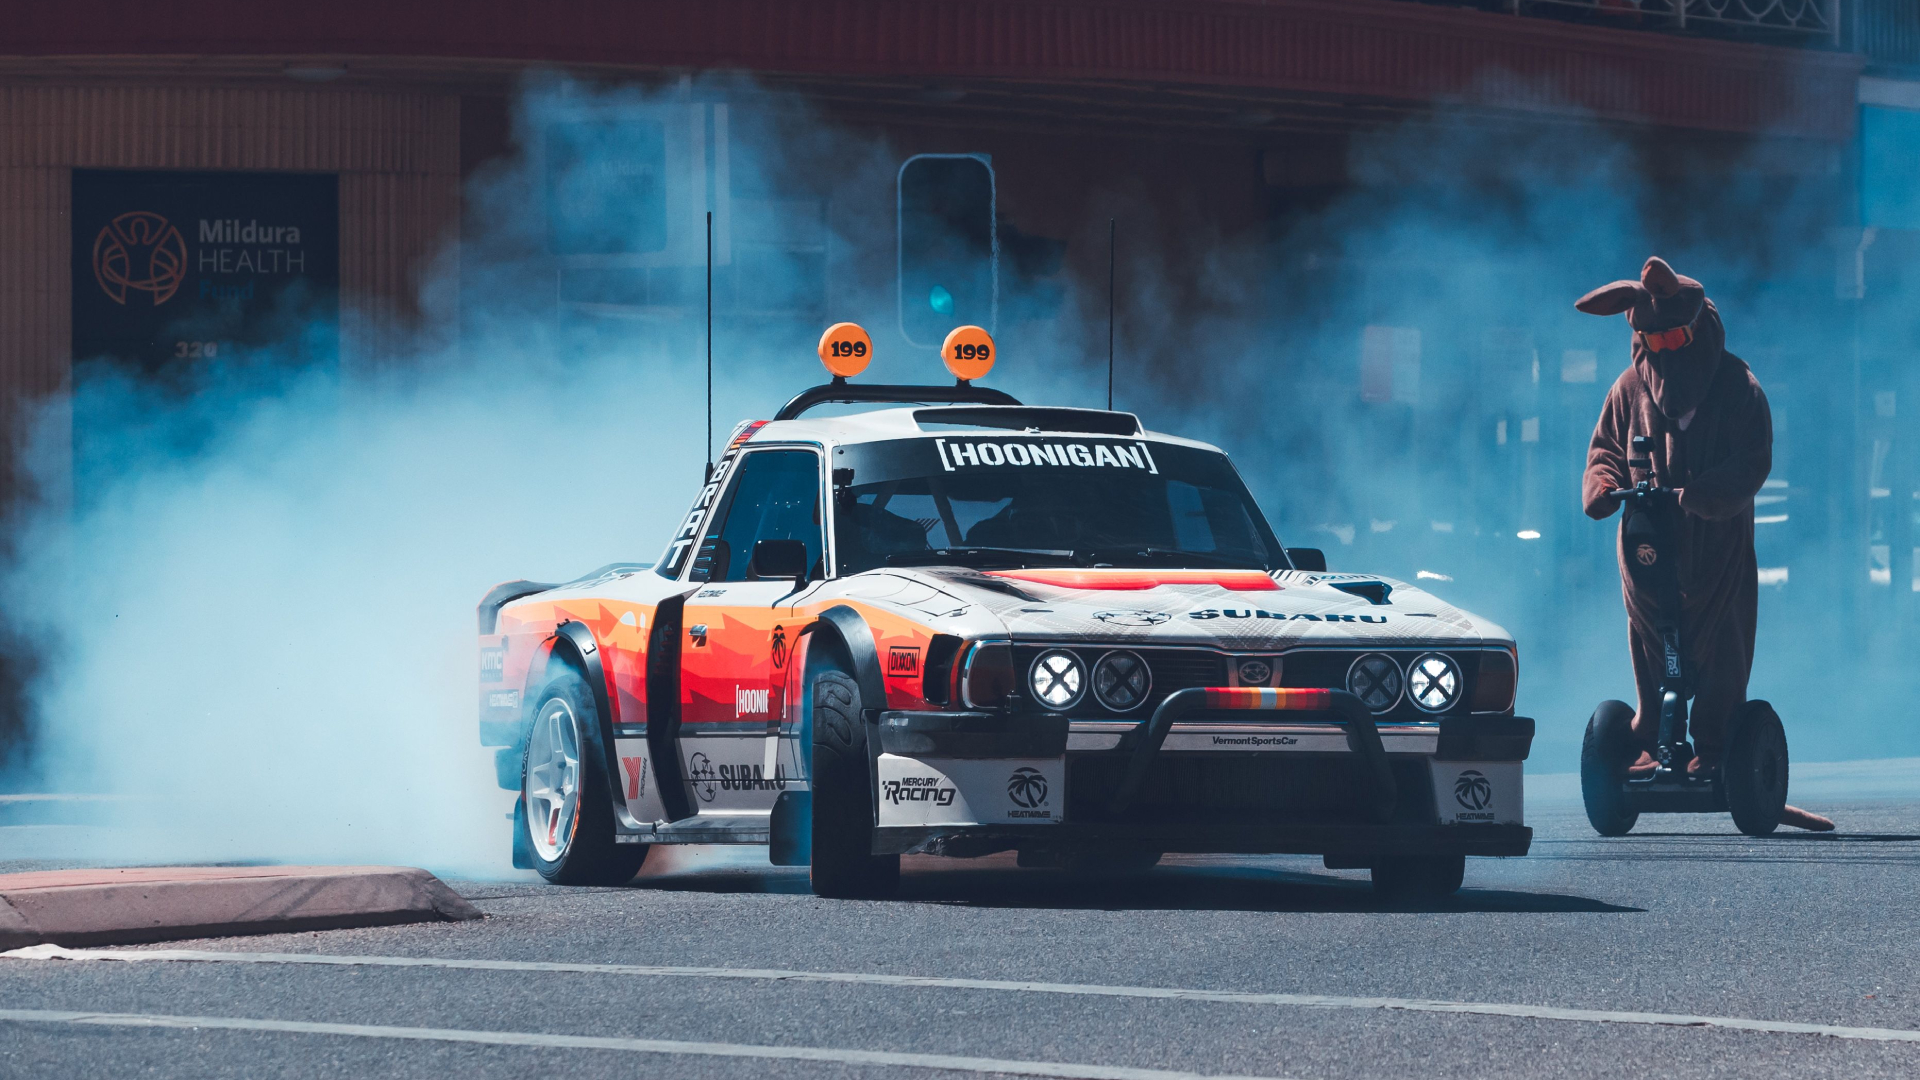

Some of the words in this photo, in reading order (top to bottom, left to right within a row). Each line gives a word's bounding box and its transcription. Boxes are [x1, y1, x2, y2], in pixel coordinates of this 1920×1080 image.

[200, 219, 300, 244] Mildura
[199, 249, 304, 273] HEALTH
[200, 279, 254, 299] Fund
[174, 341, 217, 358] 320
[831, 341, 867, 358] 199
[954, 344, 990, 361] 199
[667, 460, 731, 569] BRAT
[1188, 608, 1387, 624] SUBARU
[891, 650, 917, 672] DIXXON
[902, 777, 939, 787] MERCURY
[884, 780, 957, 807] Racing
